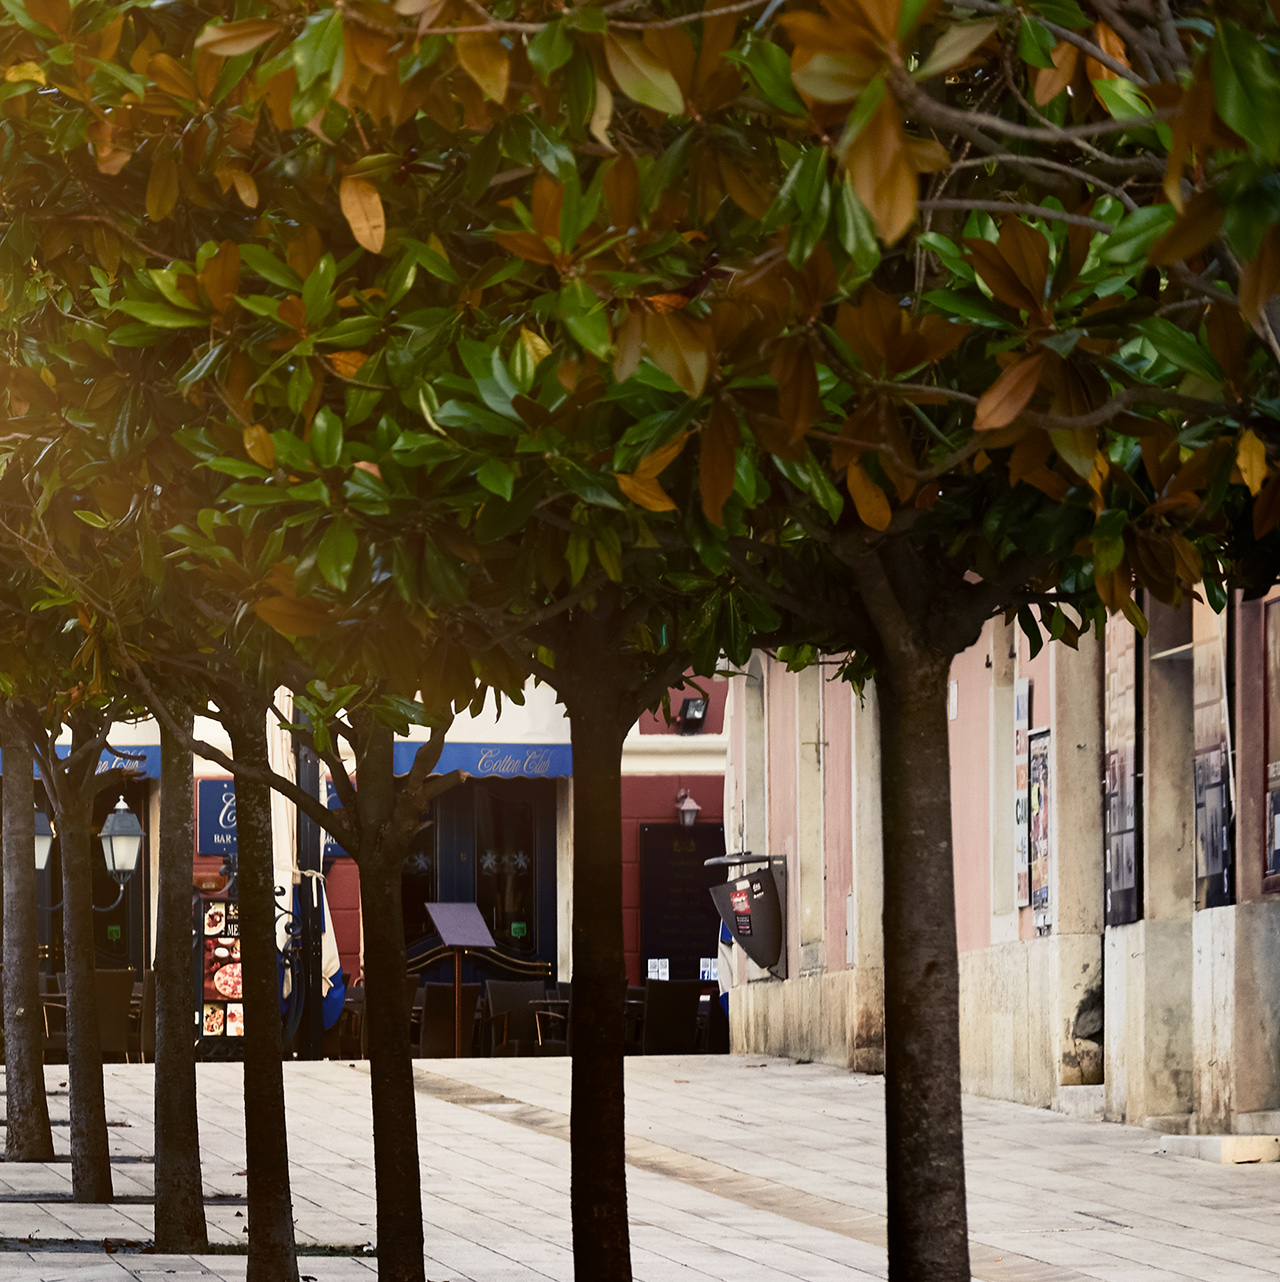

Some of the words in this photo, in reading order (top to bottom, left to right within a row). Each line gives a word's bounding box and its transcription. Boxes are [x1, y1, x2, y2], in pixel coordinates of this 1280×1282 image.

[478, 748, 521, 773] Cotton
[523, 748, 557, 774] Club
[213, 833, 232, 844] BAR
